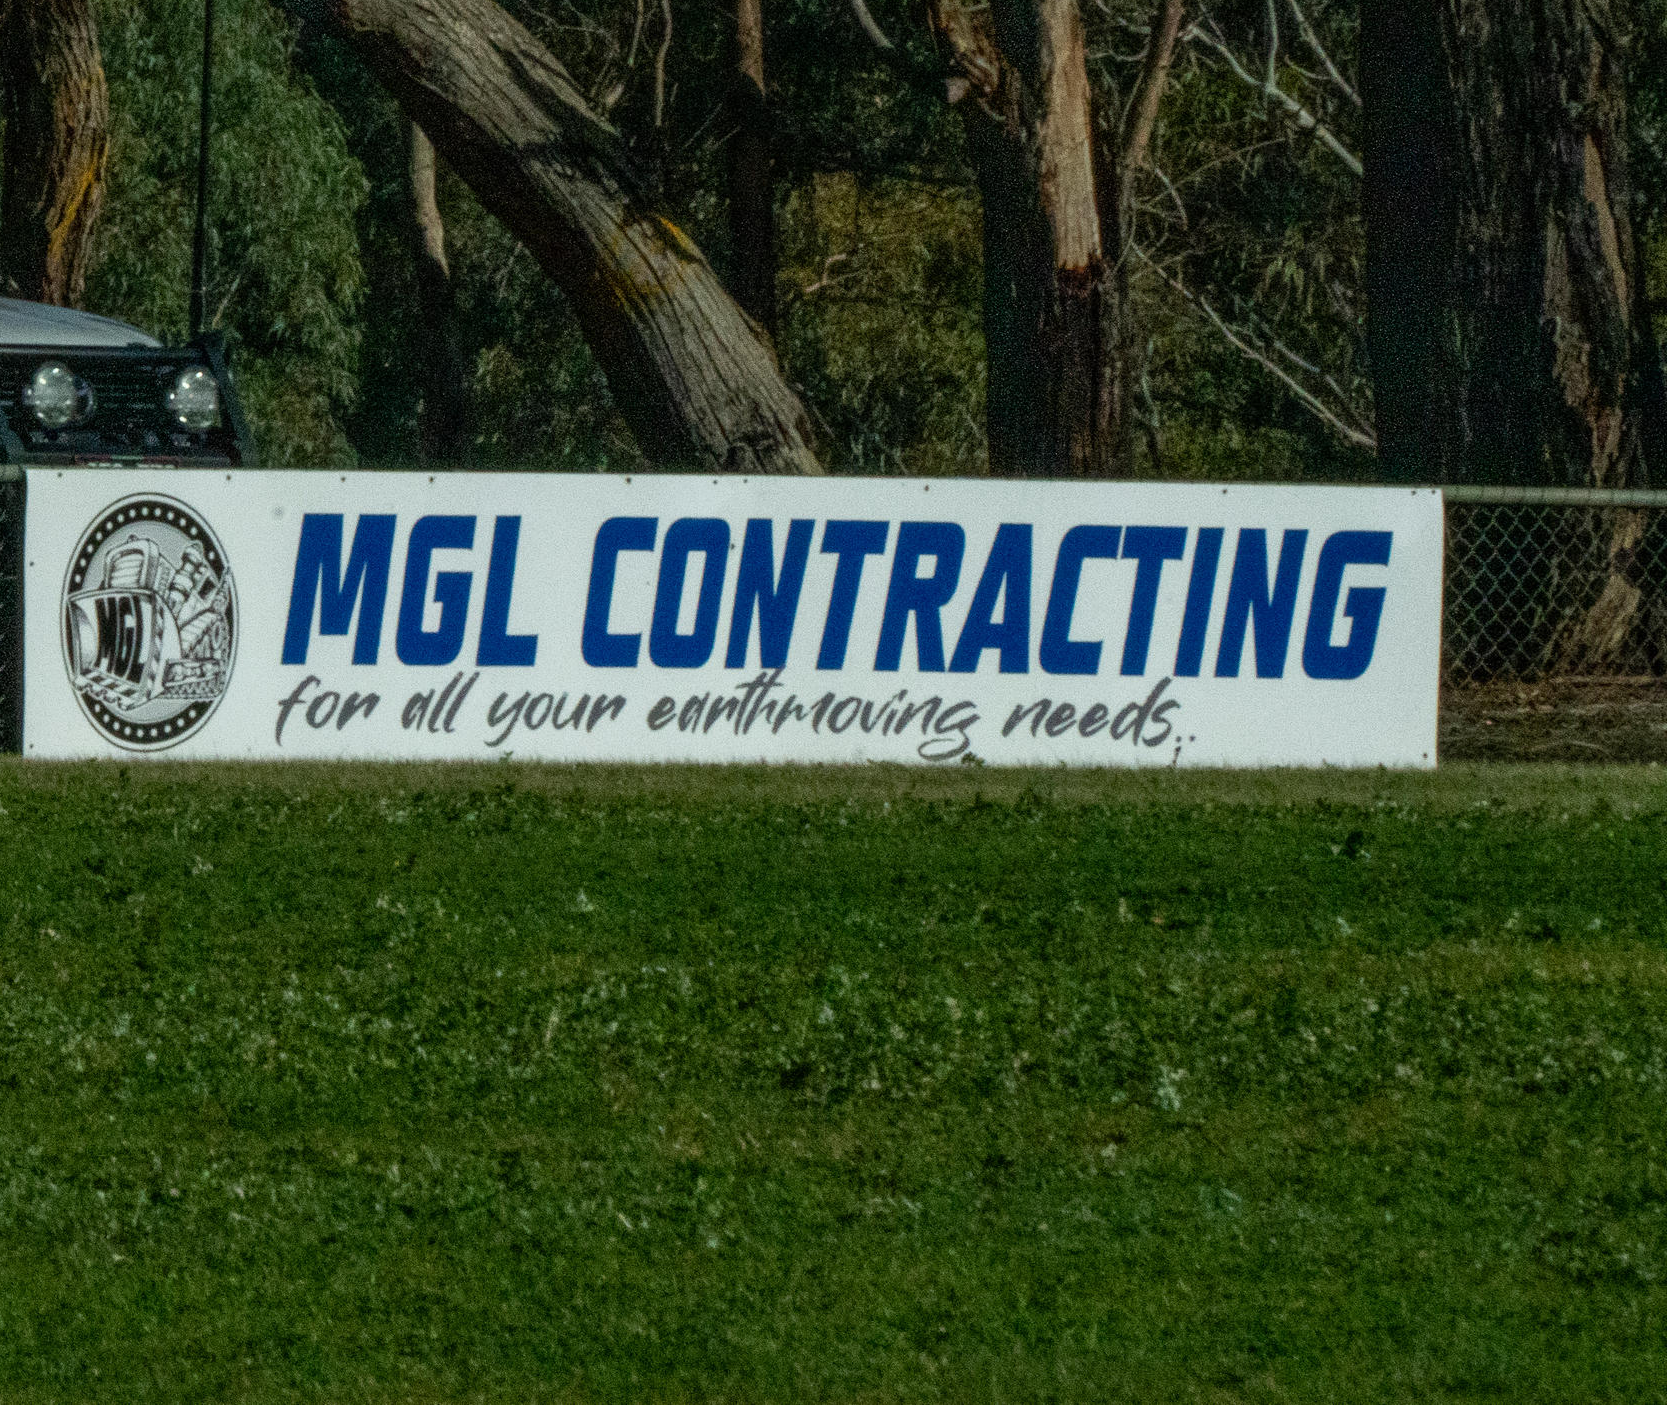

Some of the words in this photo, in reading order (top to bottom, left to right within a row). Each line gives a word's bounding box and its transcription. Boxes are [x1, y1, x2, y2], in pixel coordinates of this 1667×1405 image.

[281, 513, 538, 667] MGL
[580, 516, 1394, 680] CONTRACTING
[275, 675, 380, 746] for
[400, 672, 480, 733] all
[484, 689, 626, 747] your
[647, 666, 981, 762] earthmoving
